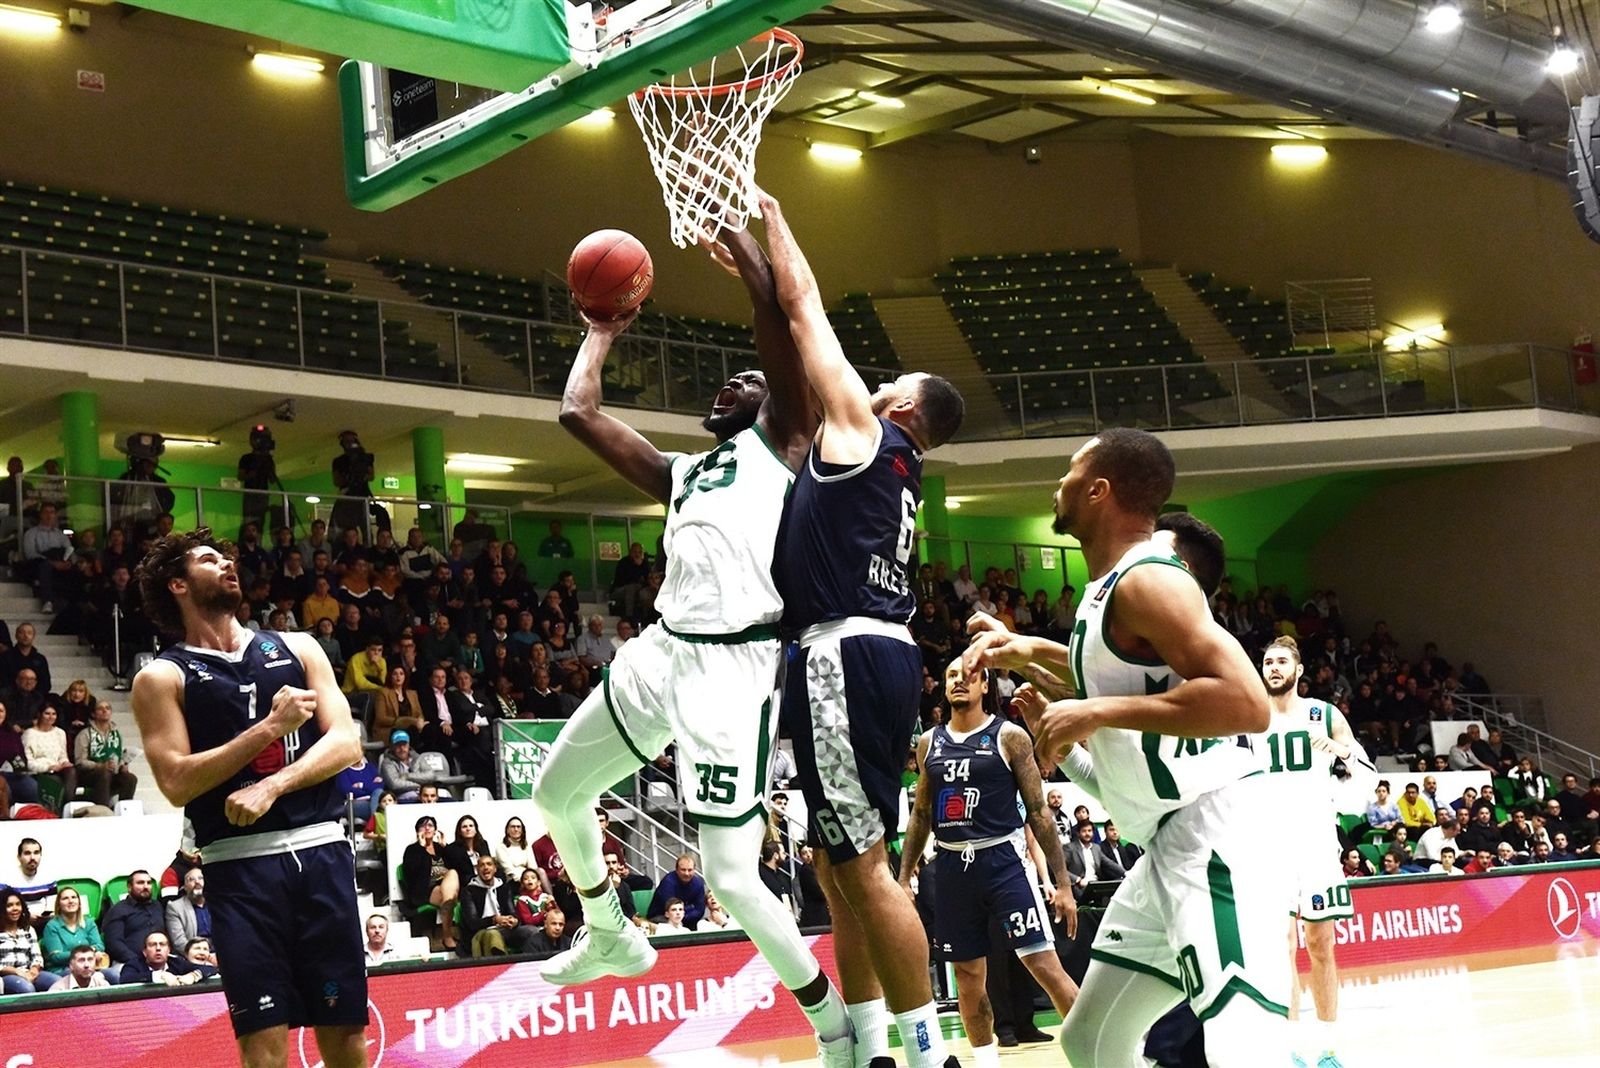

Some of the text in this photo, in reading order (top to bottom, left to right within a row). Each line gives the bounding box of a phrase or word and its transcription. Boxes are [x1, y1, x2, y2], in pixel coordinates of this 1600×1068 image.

[895, 486, 917, 565] 6
[239, 682, 257, 719] 7
[943, 758, 970, 782] 34
[1267, 730, 1312, 773] 10
[695, 763, 738, 805] 35
[816, 808, 844, 846] 6
[1326, 885, 1351, 908] 10
[1009, 907, 1041, 937] 34
[1371, 904, 1463, 942] AIRLINES
[405, 973, 776, 1053] TURKISH AIRLINES
